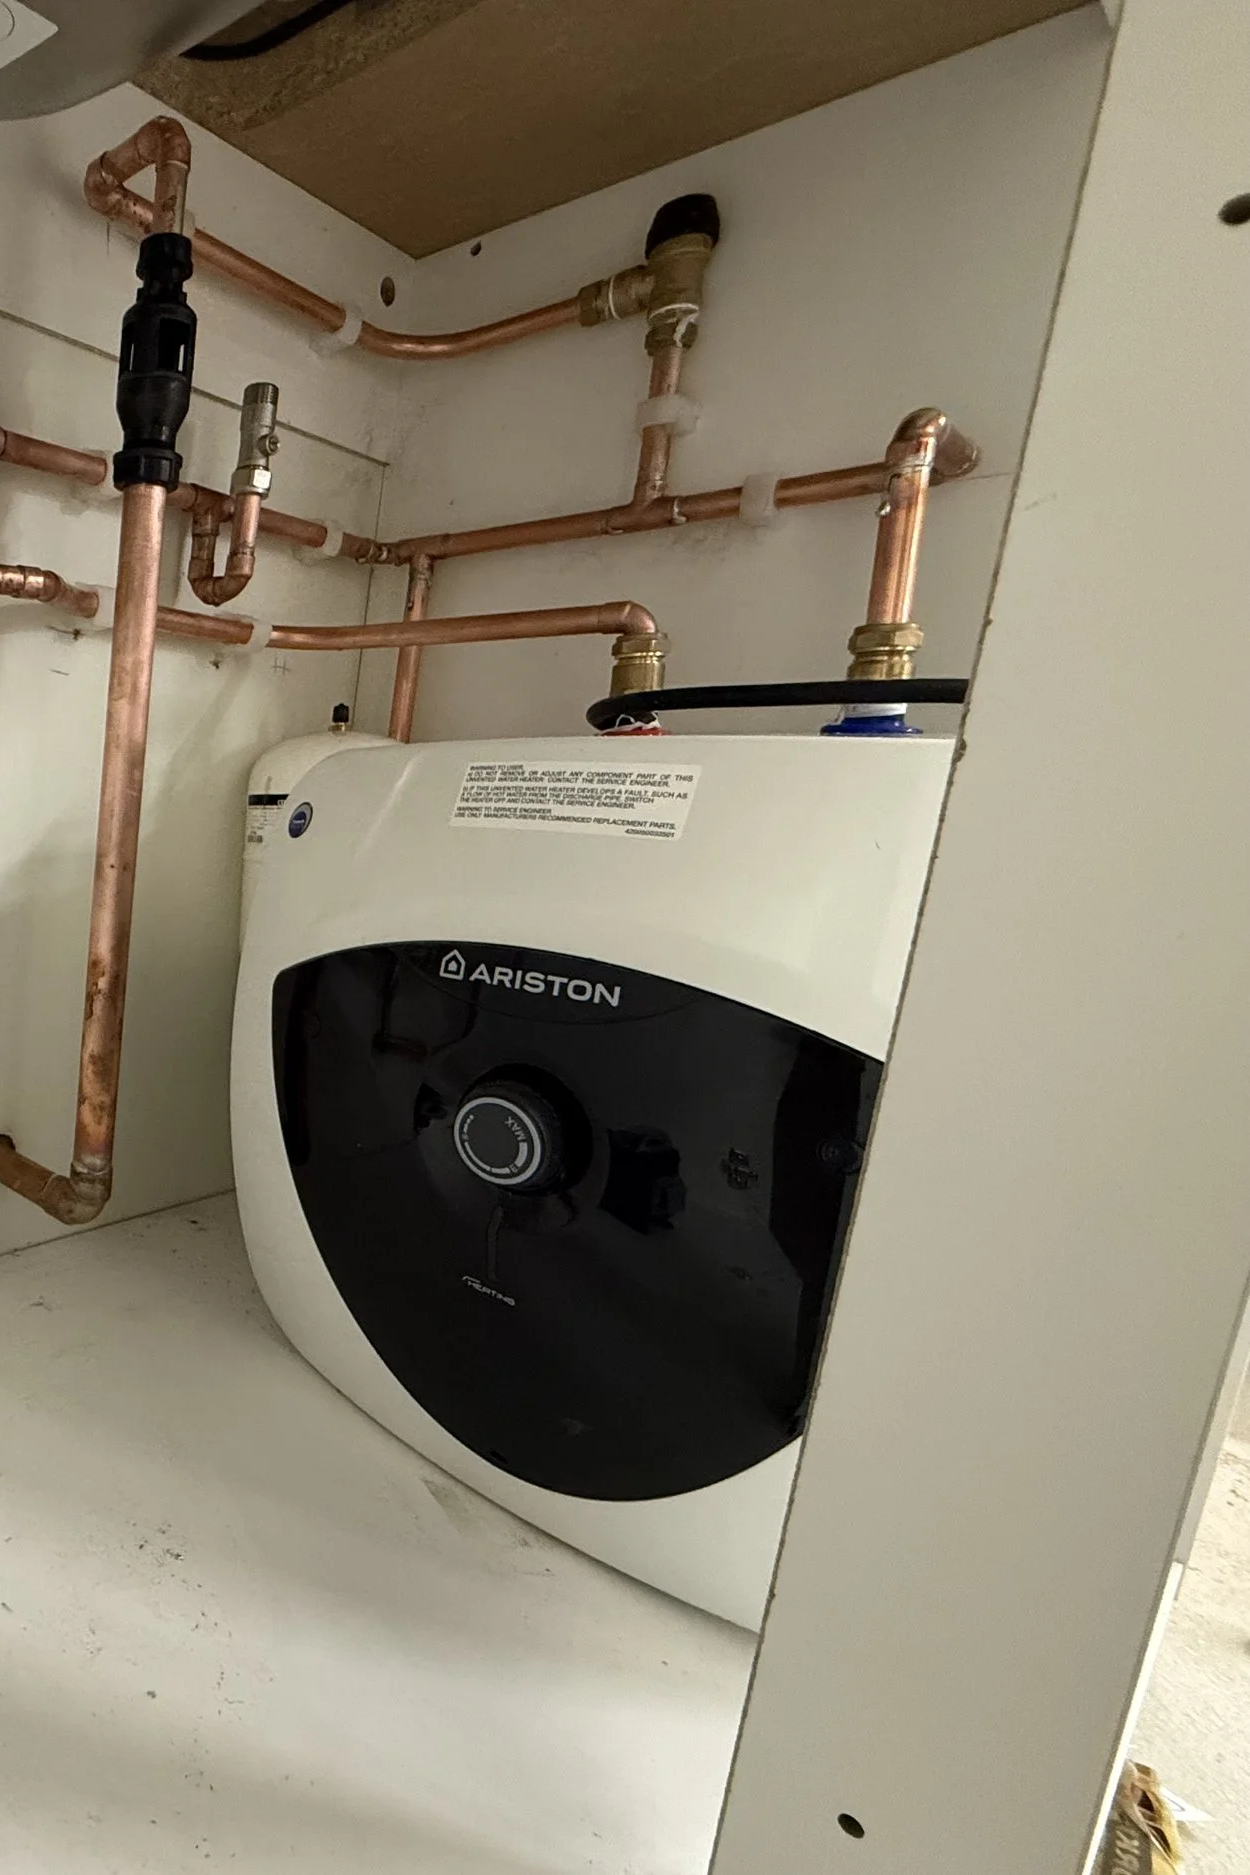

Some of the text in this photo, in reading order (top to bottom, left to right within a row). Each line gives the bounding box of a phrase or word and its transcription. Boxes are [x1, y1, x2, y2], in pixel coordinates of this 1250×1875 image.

[586, 771, 634, 780] COMPONENT
[675, 774, 694, 783] THIS
[596, 778, 627, 786] SERVICE
[490, 785, 524, 793] UNVENTED
[549, 786, 577, 794] HEATER
[577, 787, 616, 795] DEVELOPS
[651, 790, 675, 799] SUCH
[675, 792, 689, 800] AS
[506, 791, 528, 799] WATER
[549, 792, 562, 800] THE
[562, 793, 603, 801] DISCHARGE
[624, 796, 654, 804] SWITCH
[538, 815, 593, 823] RECOMMENDED
[593, 817, 647, 827] REPLACEMENT
[468, 962, 622, 1007] ARISTON
[504, 1115, 526, 1141] MAX
